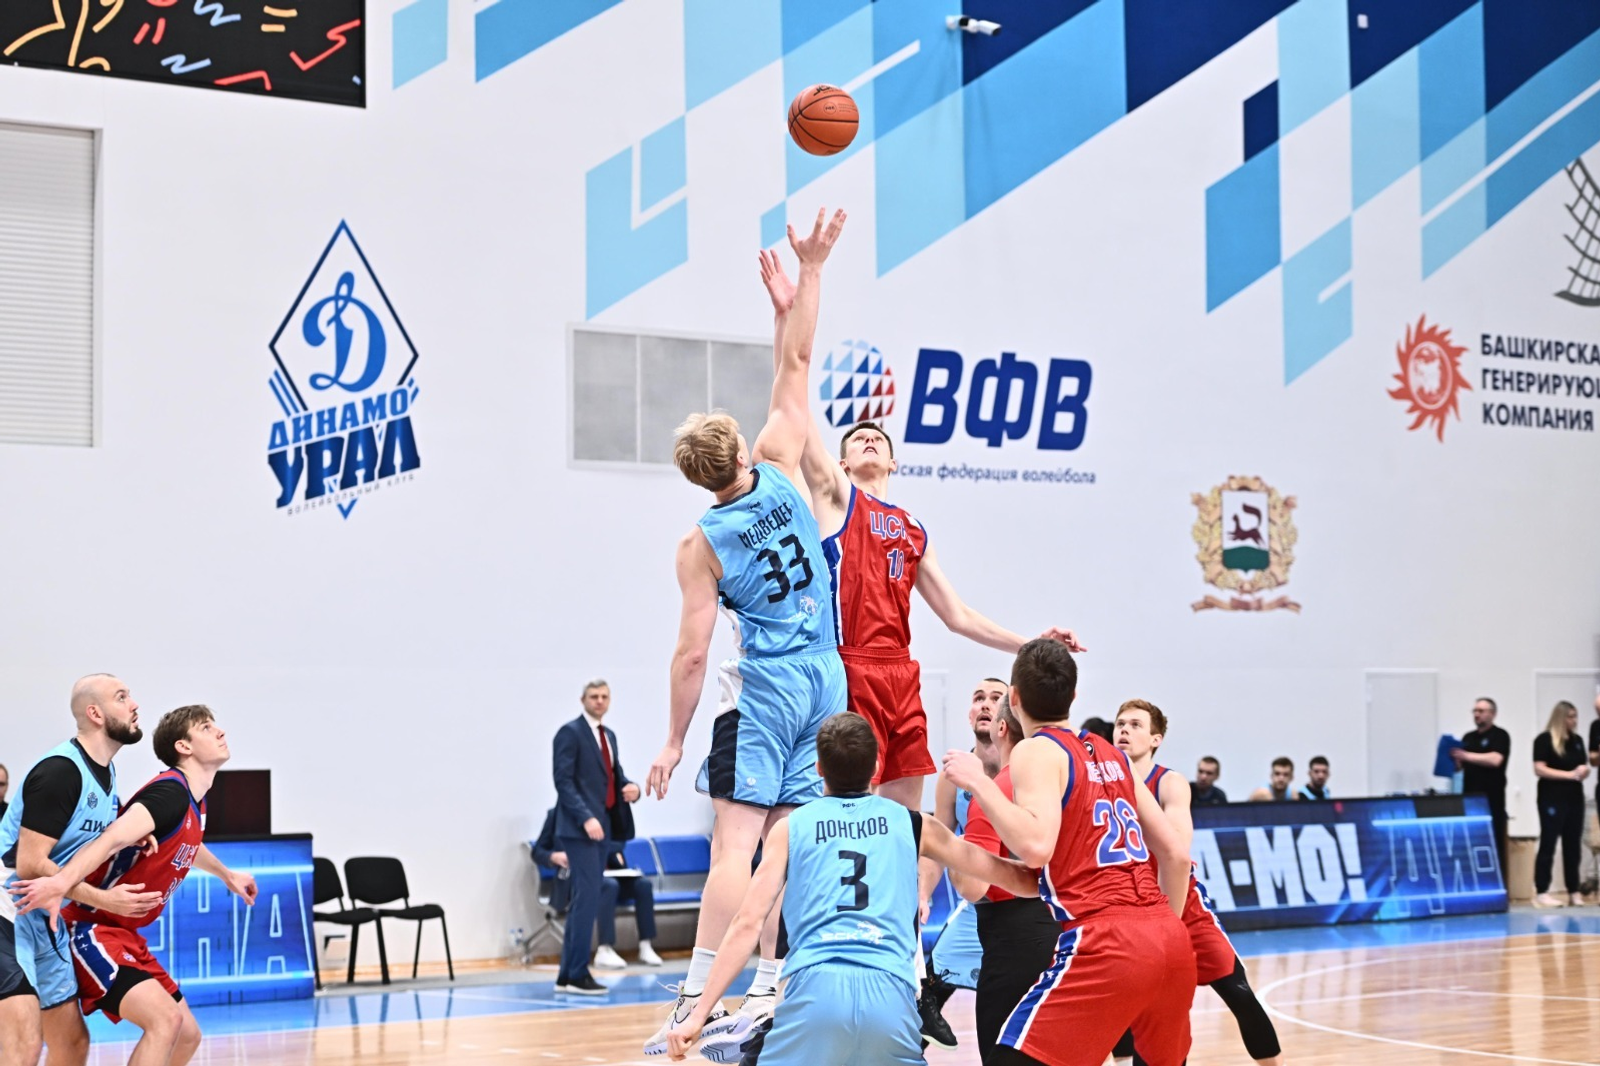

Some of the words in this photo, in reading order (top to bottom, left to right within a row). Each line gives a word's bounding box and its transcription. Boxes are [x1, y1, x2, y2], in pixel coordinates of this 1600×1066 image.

[903, 348, 1093, 451] ВФВ
[1482, 368, 1600, 399] ГЕНЕРИРУЮ
[267, 388, 409, 450] ДИНАМО
[1483, 402, 1594, 431] КОМПАНИЯ
[267, 416, 421, 509] УРАЛ
[937, 463, 1018, 483] федерация
[1022, 467, 1097, 484] волейбола
[286, 484, 380, 516] ВОЛЕЙБОЛЬНЫЙ
[386, 474, 414, 488] КЛУБ
[757, 534, 814, 604] 33
[815, 816, 889, 845] ДОНСКОВ
[1093, 797, 1150, 868] 26
[836, 850, 870, 913] 3
